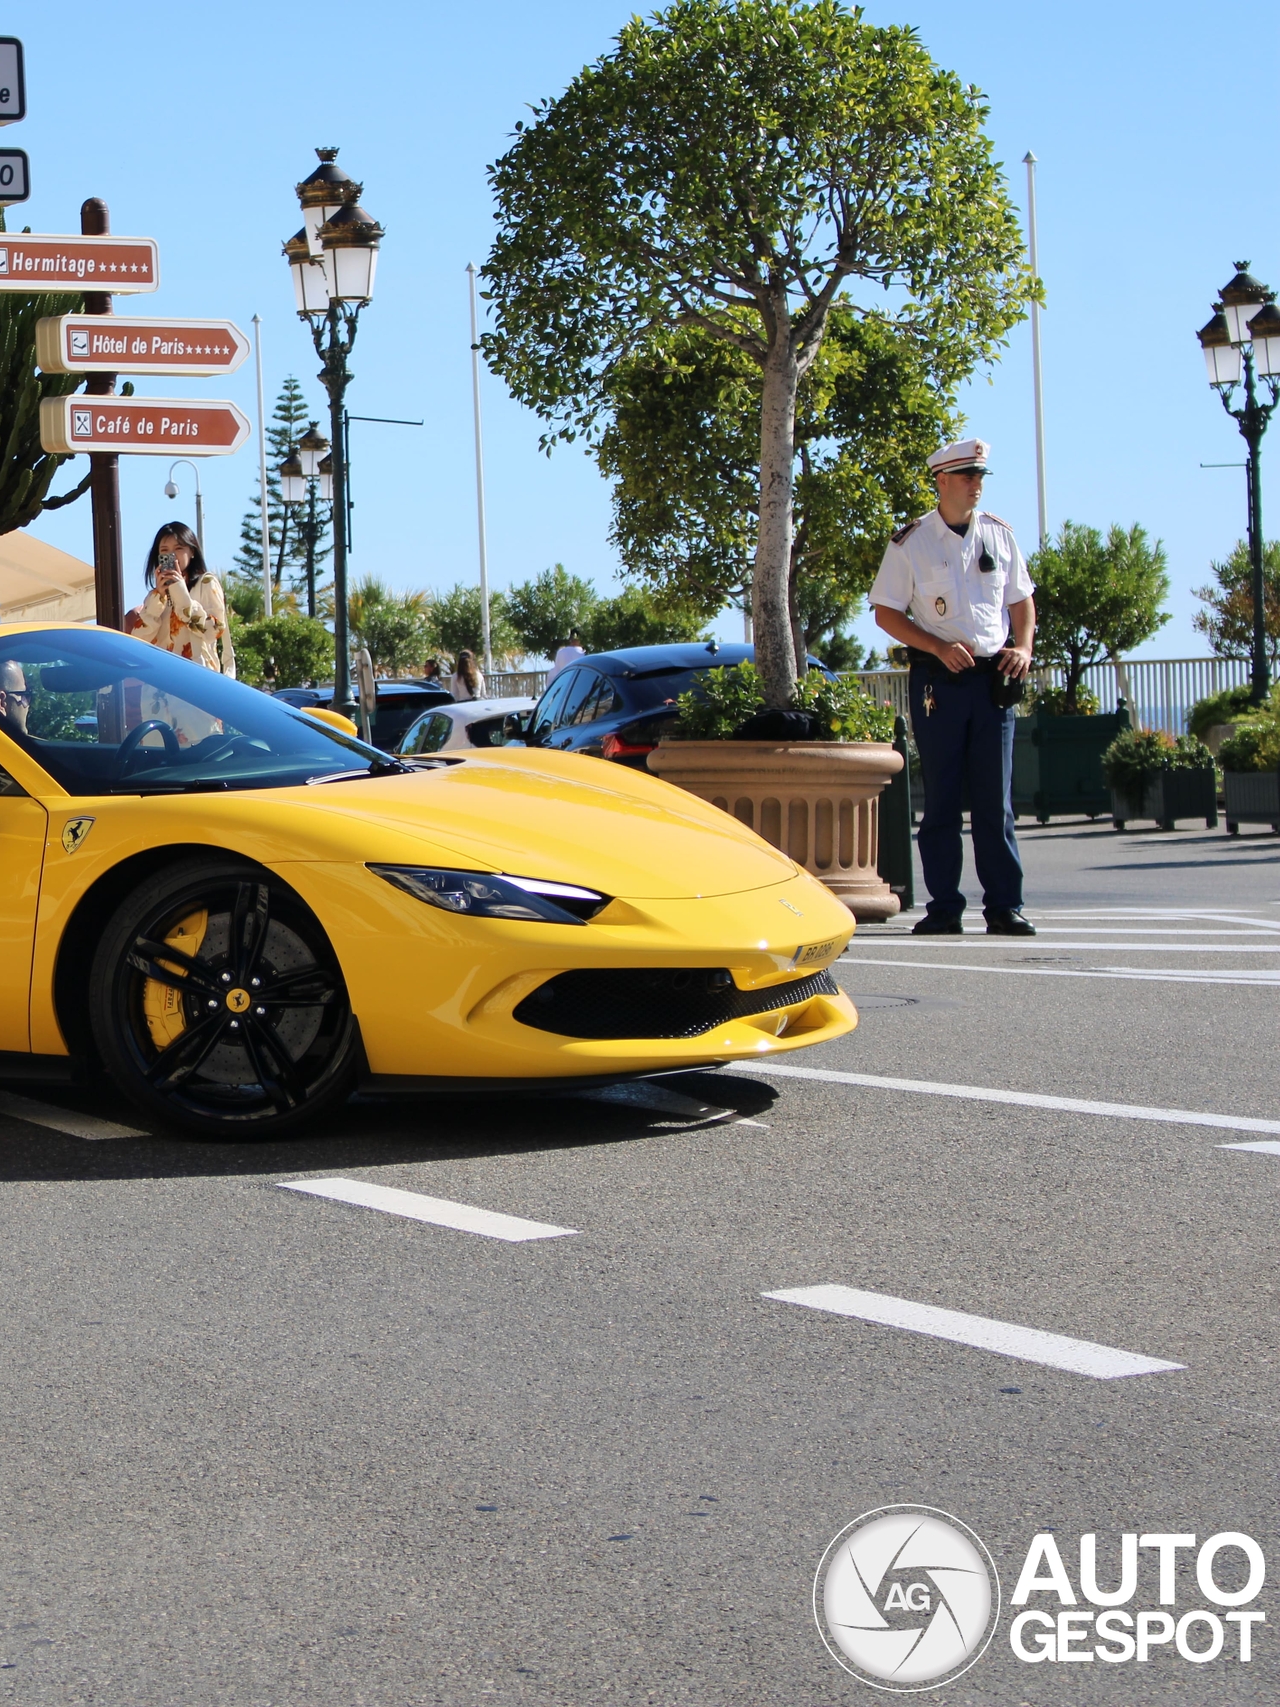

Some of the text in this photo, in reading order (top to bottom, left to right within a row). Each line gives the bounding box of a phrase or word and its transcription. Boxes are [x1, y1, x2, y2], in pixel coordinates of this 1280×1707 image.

[12, 252, 96, 278] Hermitage
[92, 335, 184, 355] Hôtel de Paris
[96, 415, 199, 436] Café de Paris
